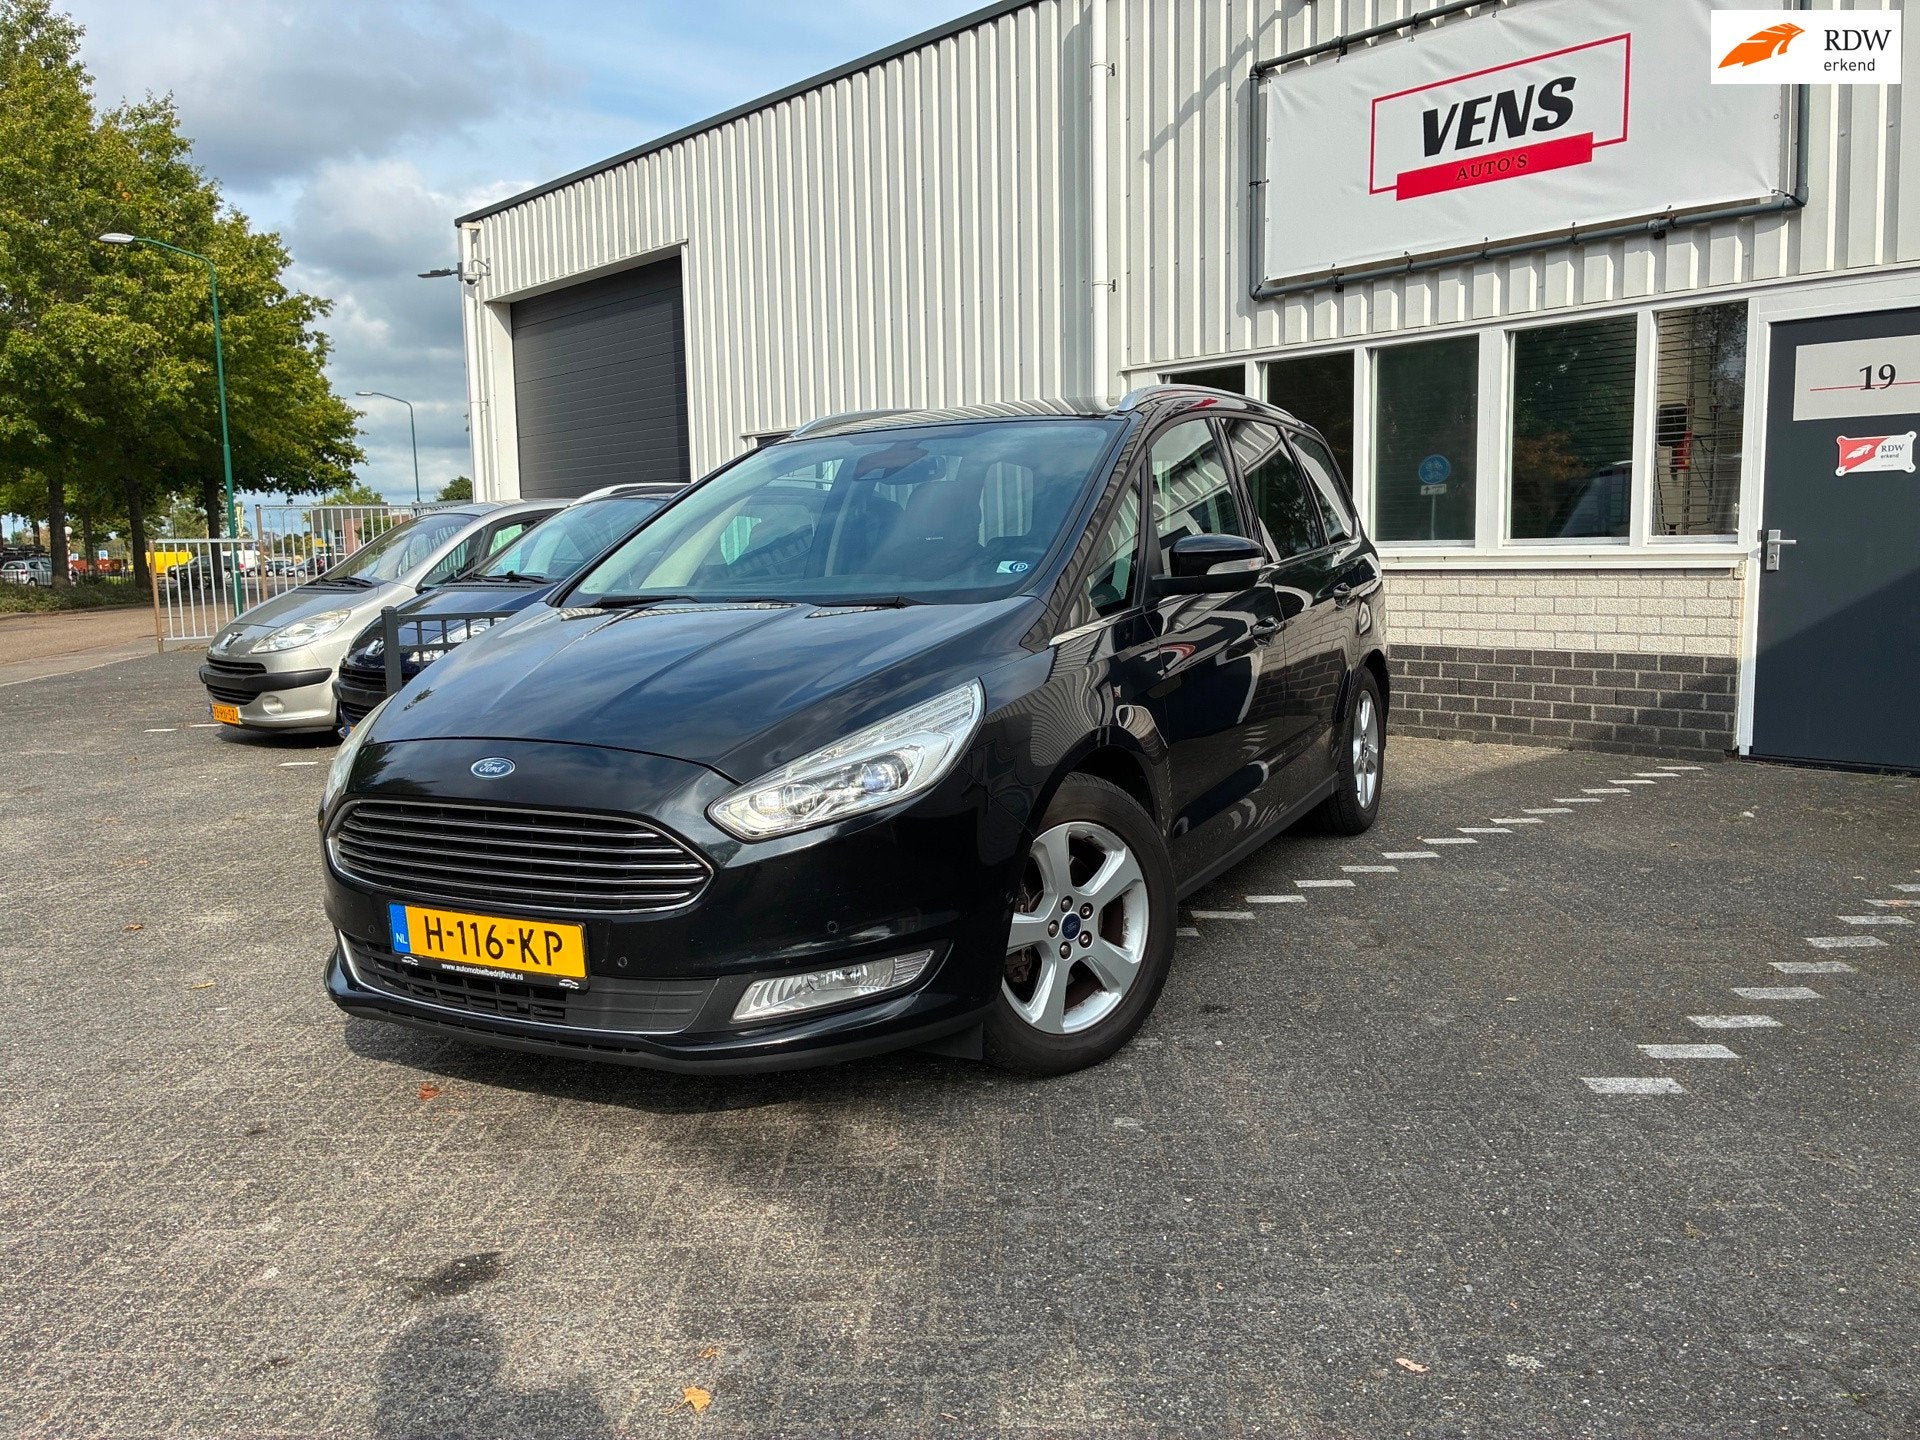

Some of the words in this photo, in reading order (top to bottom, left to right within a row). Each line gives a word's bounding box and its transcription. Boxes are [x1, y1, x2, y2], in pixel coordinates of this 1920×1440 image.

[1423, 76, 1577, 157] VENS
[1456, 154, 1528, 181] AUTO'S
[1859, 363, 1896, 391] 19
[1881, 444, 1905, 453] RDW
[479, 761, 506, 773] Ford
[395, 932, 408, 945] NL
[424, 915, 563, 967] H-116-KP
